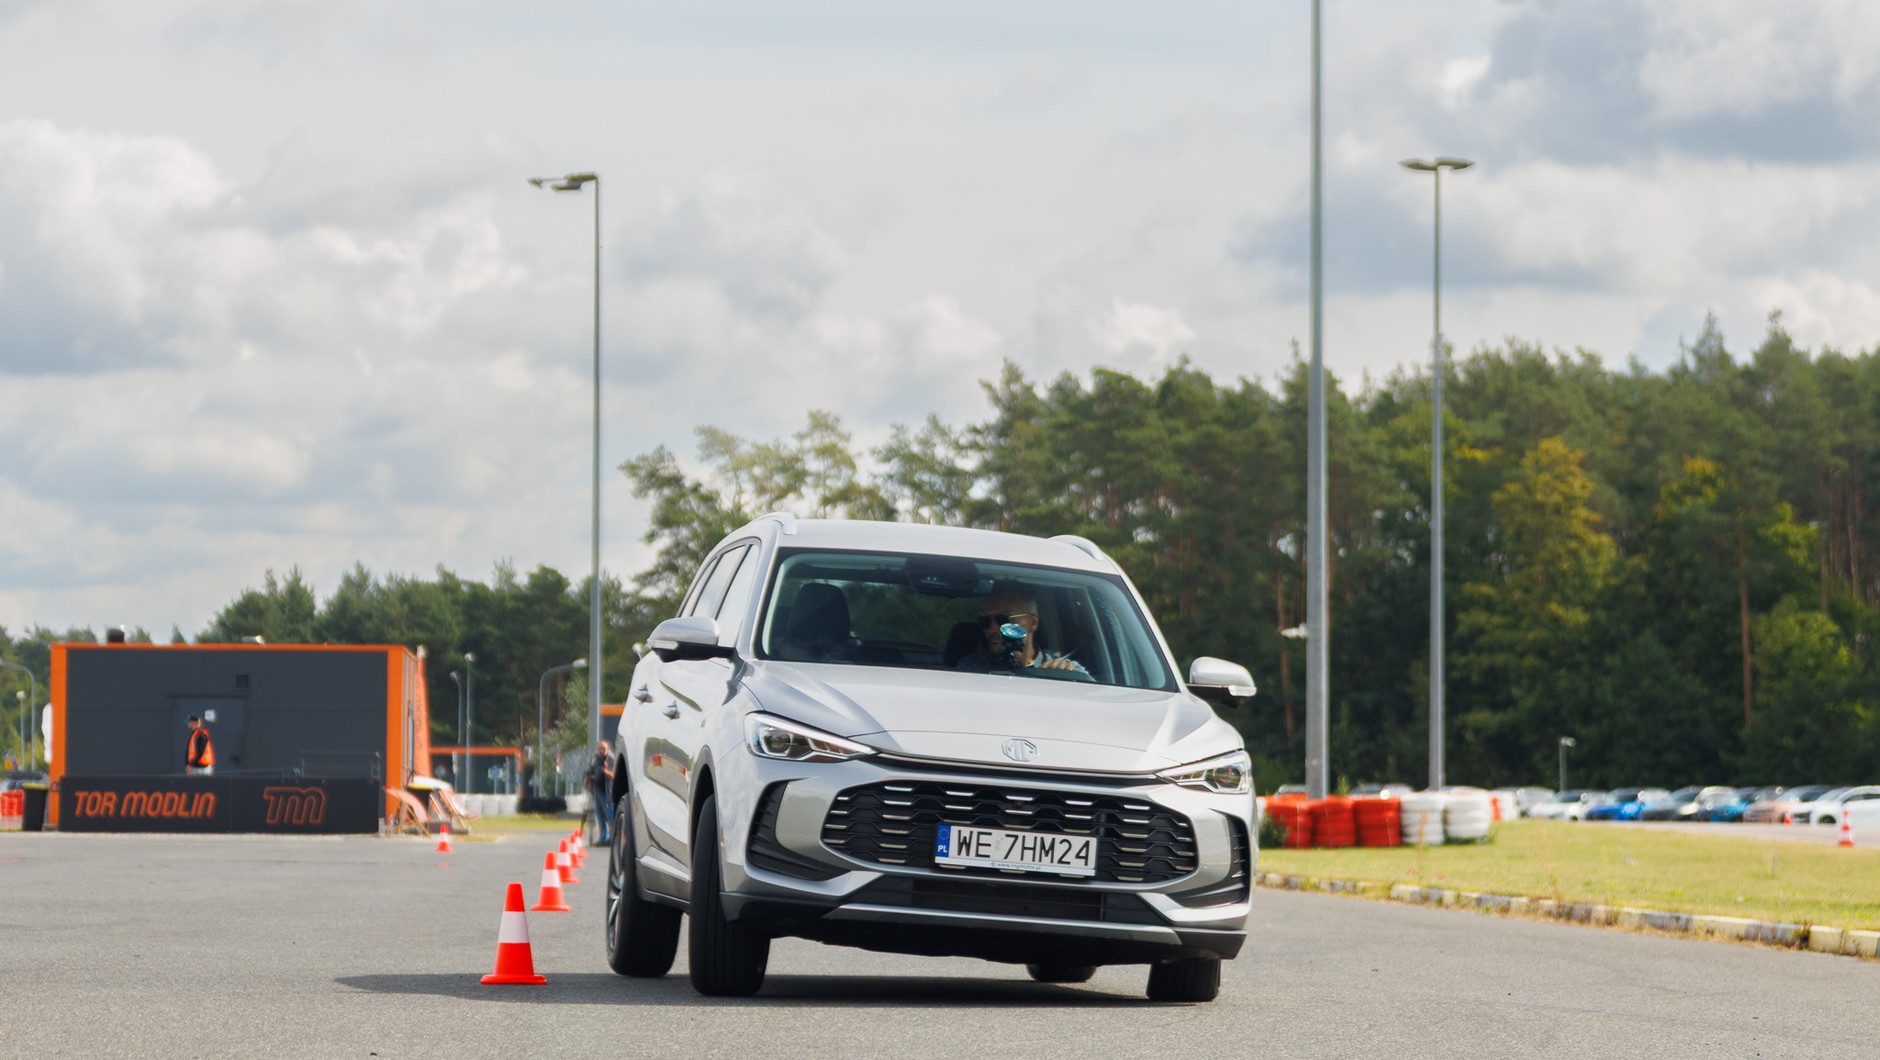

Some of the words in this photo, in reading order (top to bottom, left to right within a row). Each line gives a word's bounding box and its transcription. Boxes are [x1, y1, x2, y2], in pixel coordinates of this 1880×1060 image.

[1002, 739, 1037, 761] MG
[74, 791, 117, 817] TOR
[120, 791, 216, 817] MODLIN
[937, 844, 948, 853] PL
[957, 830, 993, 858] WE
[1003, 834, 1091, 866] 7HM24
